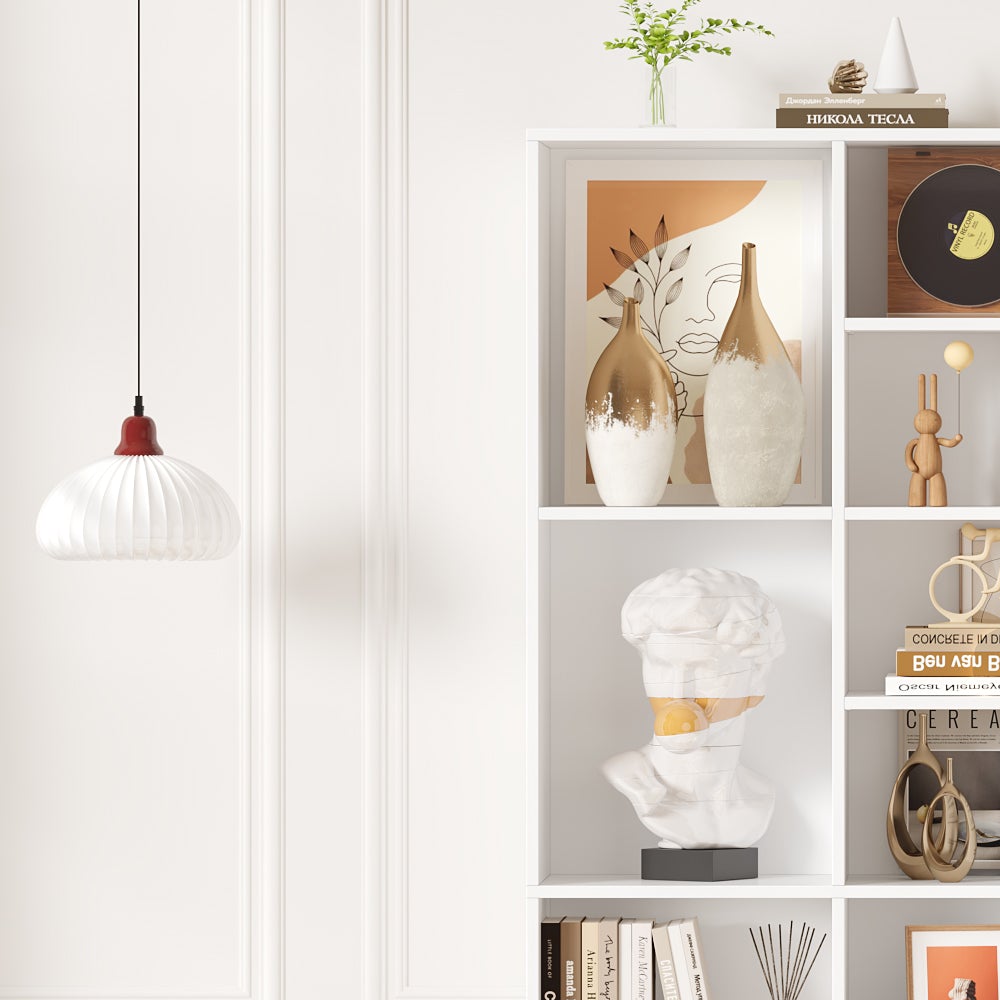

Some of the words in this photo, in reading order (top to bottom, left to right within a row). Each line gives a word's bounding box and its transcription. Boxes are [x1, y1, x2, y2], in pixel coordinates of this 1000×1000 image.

[785, 97, 822, 105] Джордан
[806, 114, 864, 125] НИКОЛА
[868, 114, 915, 125] ТЕСЛА
[952, 236, 965, 252] VINYL
[960, 211, 975, 236] RECORD
[604, 935, 613, 953] The
[638, 936, 648, 959] Karen
[587, 949, 596, 988] Arianna
[604, 956, 616, 977] body
[566, 960, 576, 997] amanda
[660, 959, 677, 1000] СПАСИТЕ
[693, 974, 702, 993] Метод
